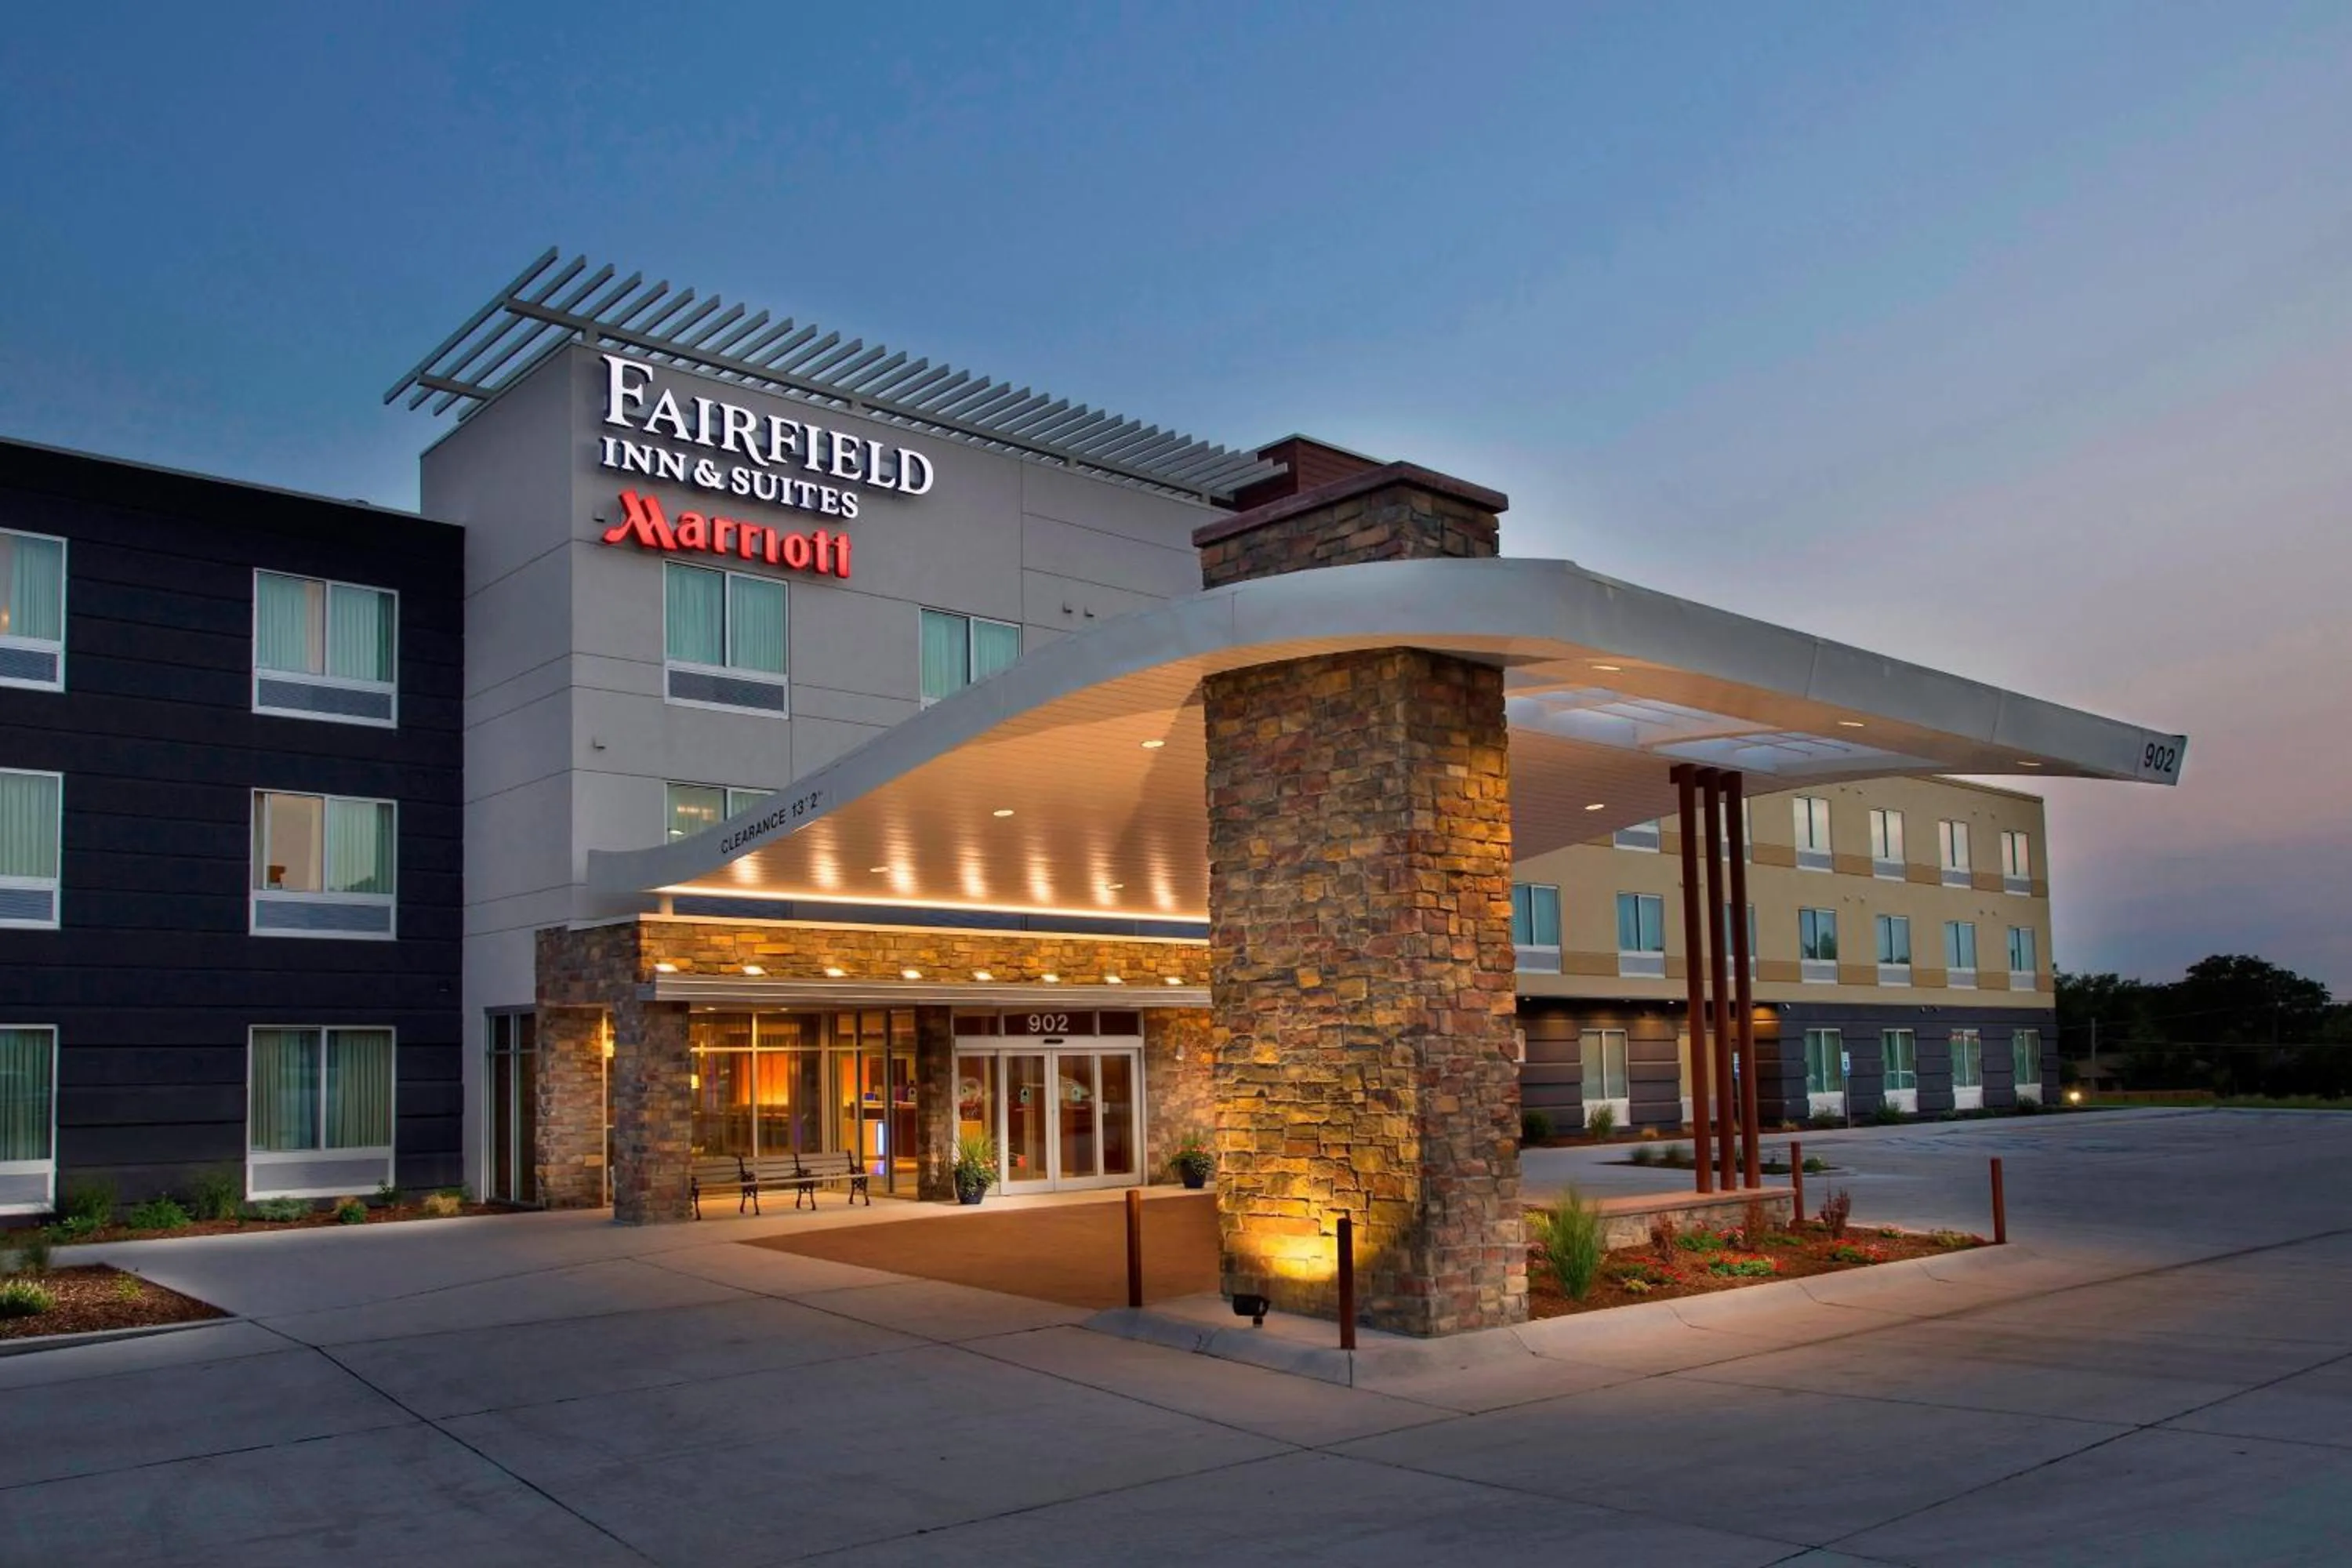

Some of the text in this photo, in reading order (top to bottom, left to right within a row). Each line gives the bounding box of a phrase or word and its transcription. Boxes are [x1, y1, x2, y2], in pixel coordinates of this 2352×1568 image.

[602, 354, 934, 495] FAIRFIELD
[601, 436, 859, 518] INN & SUITES
[602, 489, 851, 578] Marriott
[2144, 742, 2175, 772] 902
[720, 808, 786, 853] CLEARANCE
[1028, 1014, 1069, 1032] 902
